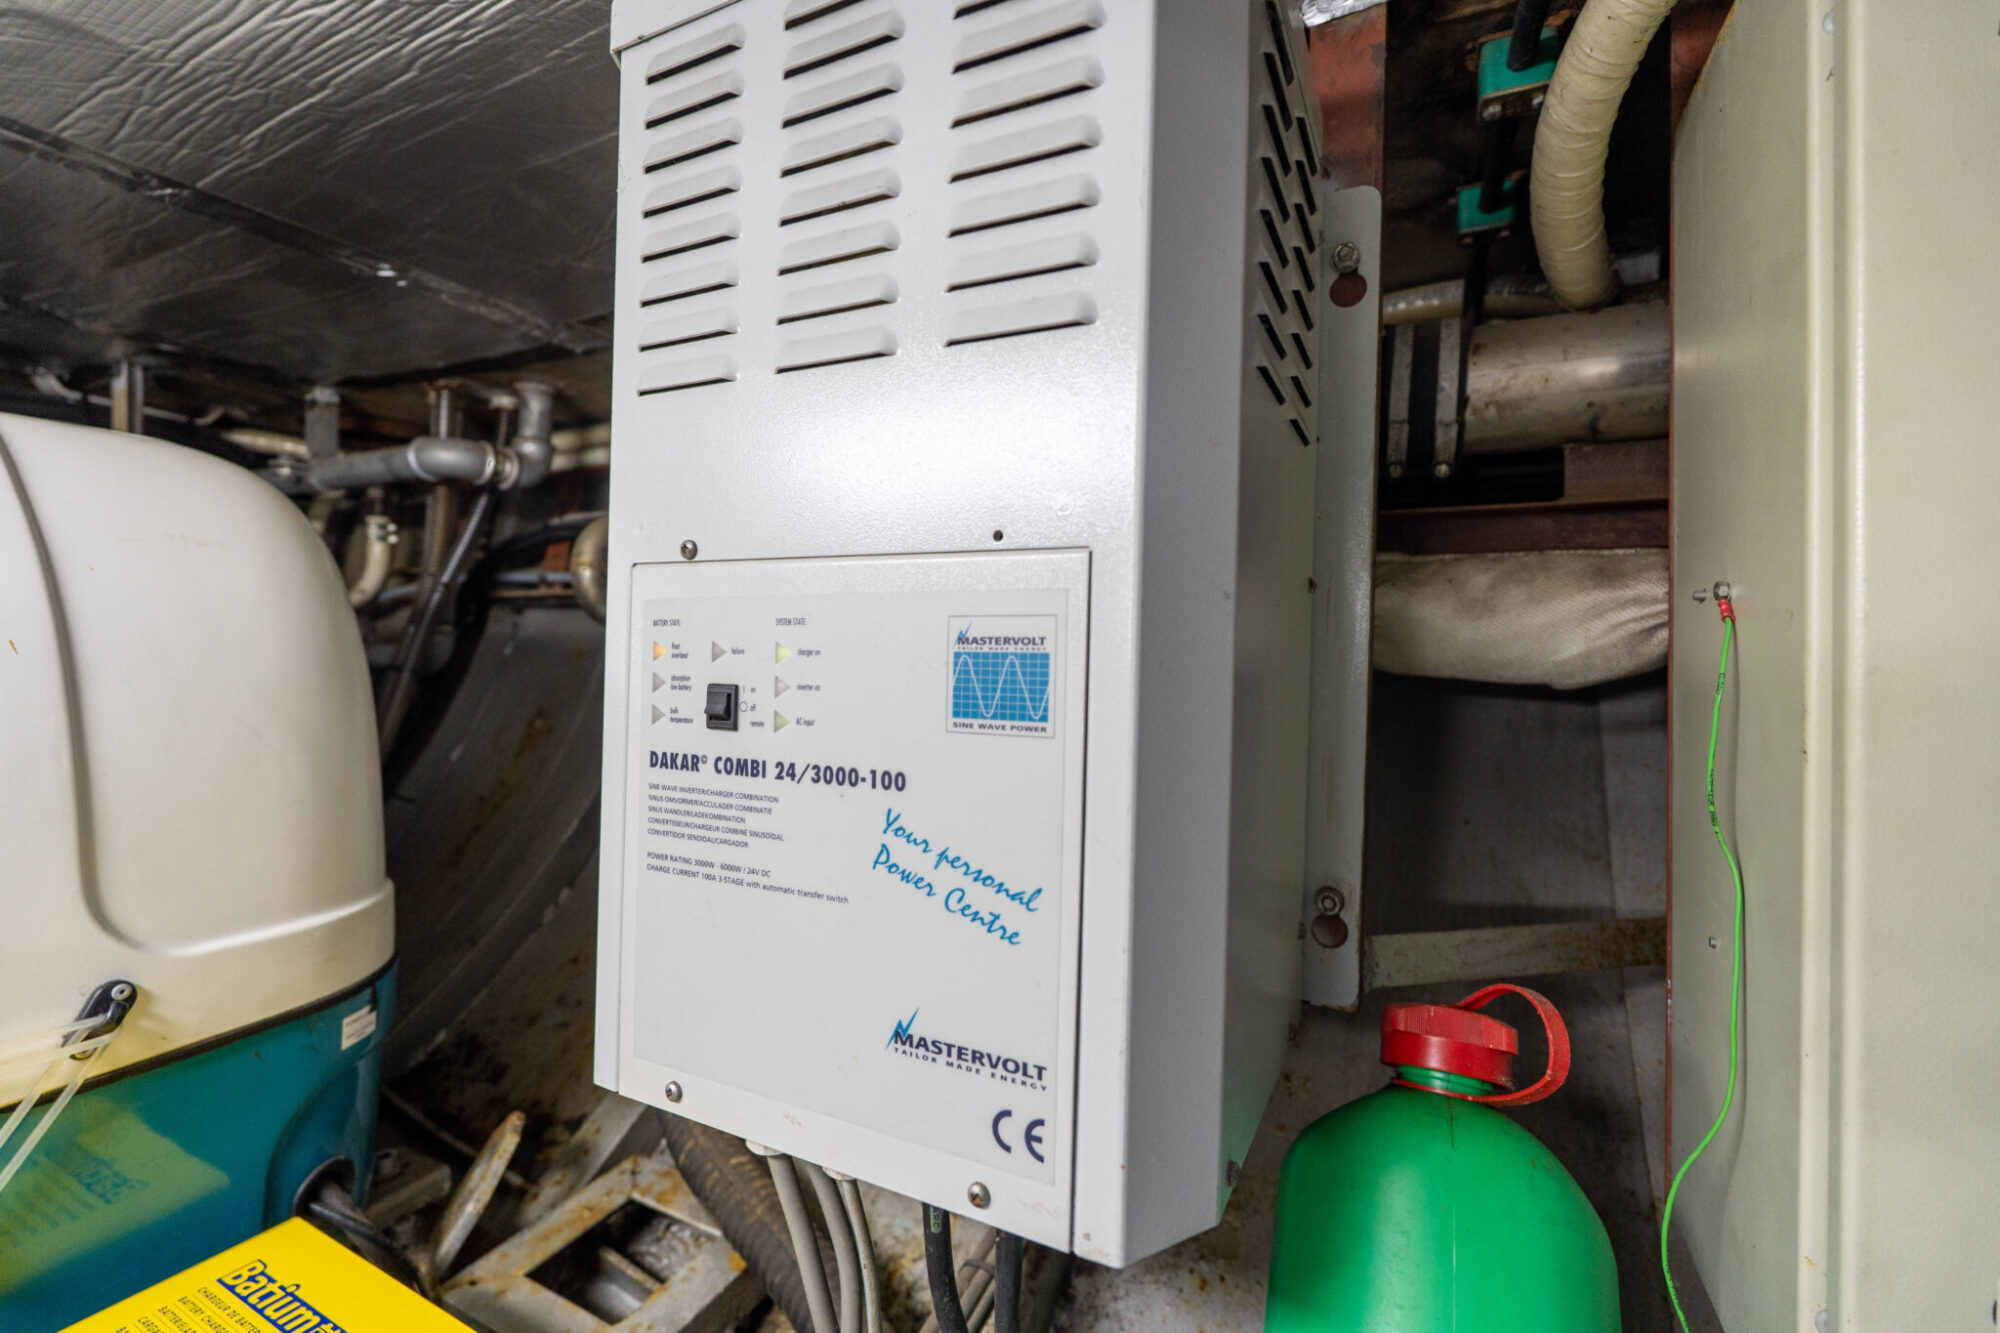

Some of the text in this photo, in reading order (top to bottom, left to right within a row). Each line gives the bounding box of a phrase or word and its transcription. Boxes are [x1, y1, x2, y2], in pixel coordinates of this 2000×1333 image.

[669, 619, 681, 627] STATE
[775, 617, 806, 626] SYSTEM STATE
[957, 636, 1047, 646] MASTERVOLT
[978, 723, 1007, 731] WAVE
[1010, 725, 1047, 733] POWER
[661, 784, 678, 792] WAVE
[713, 756, 767, 778] COMBI
[774, 762, 907, 792] 24/3000-100
[647, 851, 669, 861] POWER
[669, 854, 693, 865] RATING
[693, 858, 715, 869] 3000W
[720, 862, 742, 873] 6000W
[747, 866, 759, 876] 24V
[761, 869, 771, 878] DC
[883, 808, 1043, 912] Your personal
[646, 863, 849, 904] CHARGE CURRENT 100A 3-STAGE with automatic transfer switch
[872, 843, 1021, 945] Power Centre
[894, 1029, 1047, 1081] MASTERVOLT
[894, 1047, 1047, 1092] TAILOR MADE ENERGY
[178, 1296, 205, 1316] BATTERY
[217, 1259, 322, 1333] Batium
